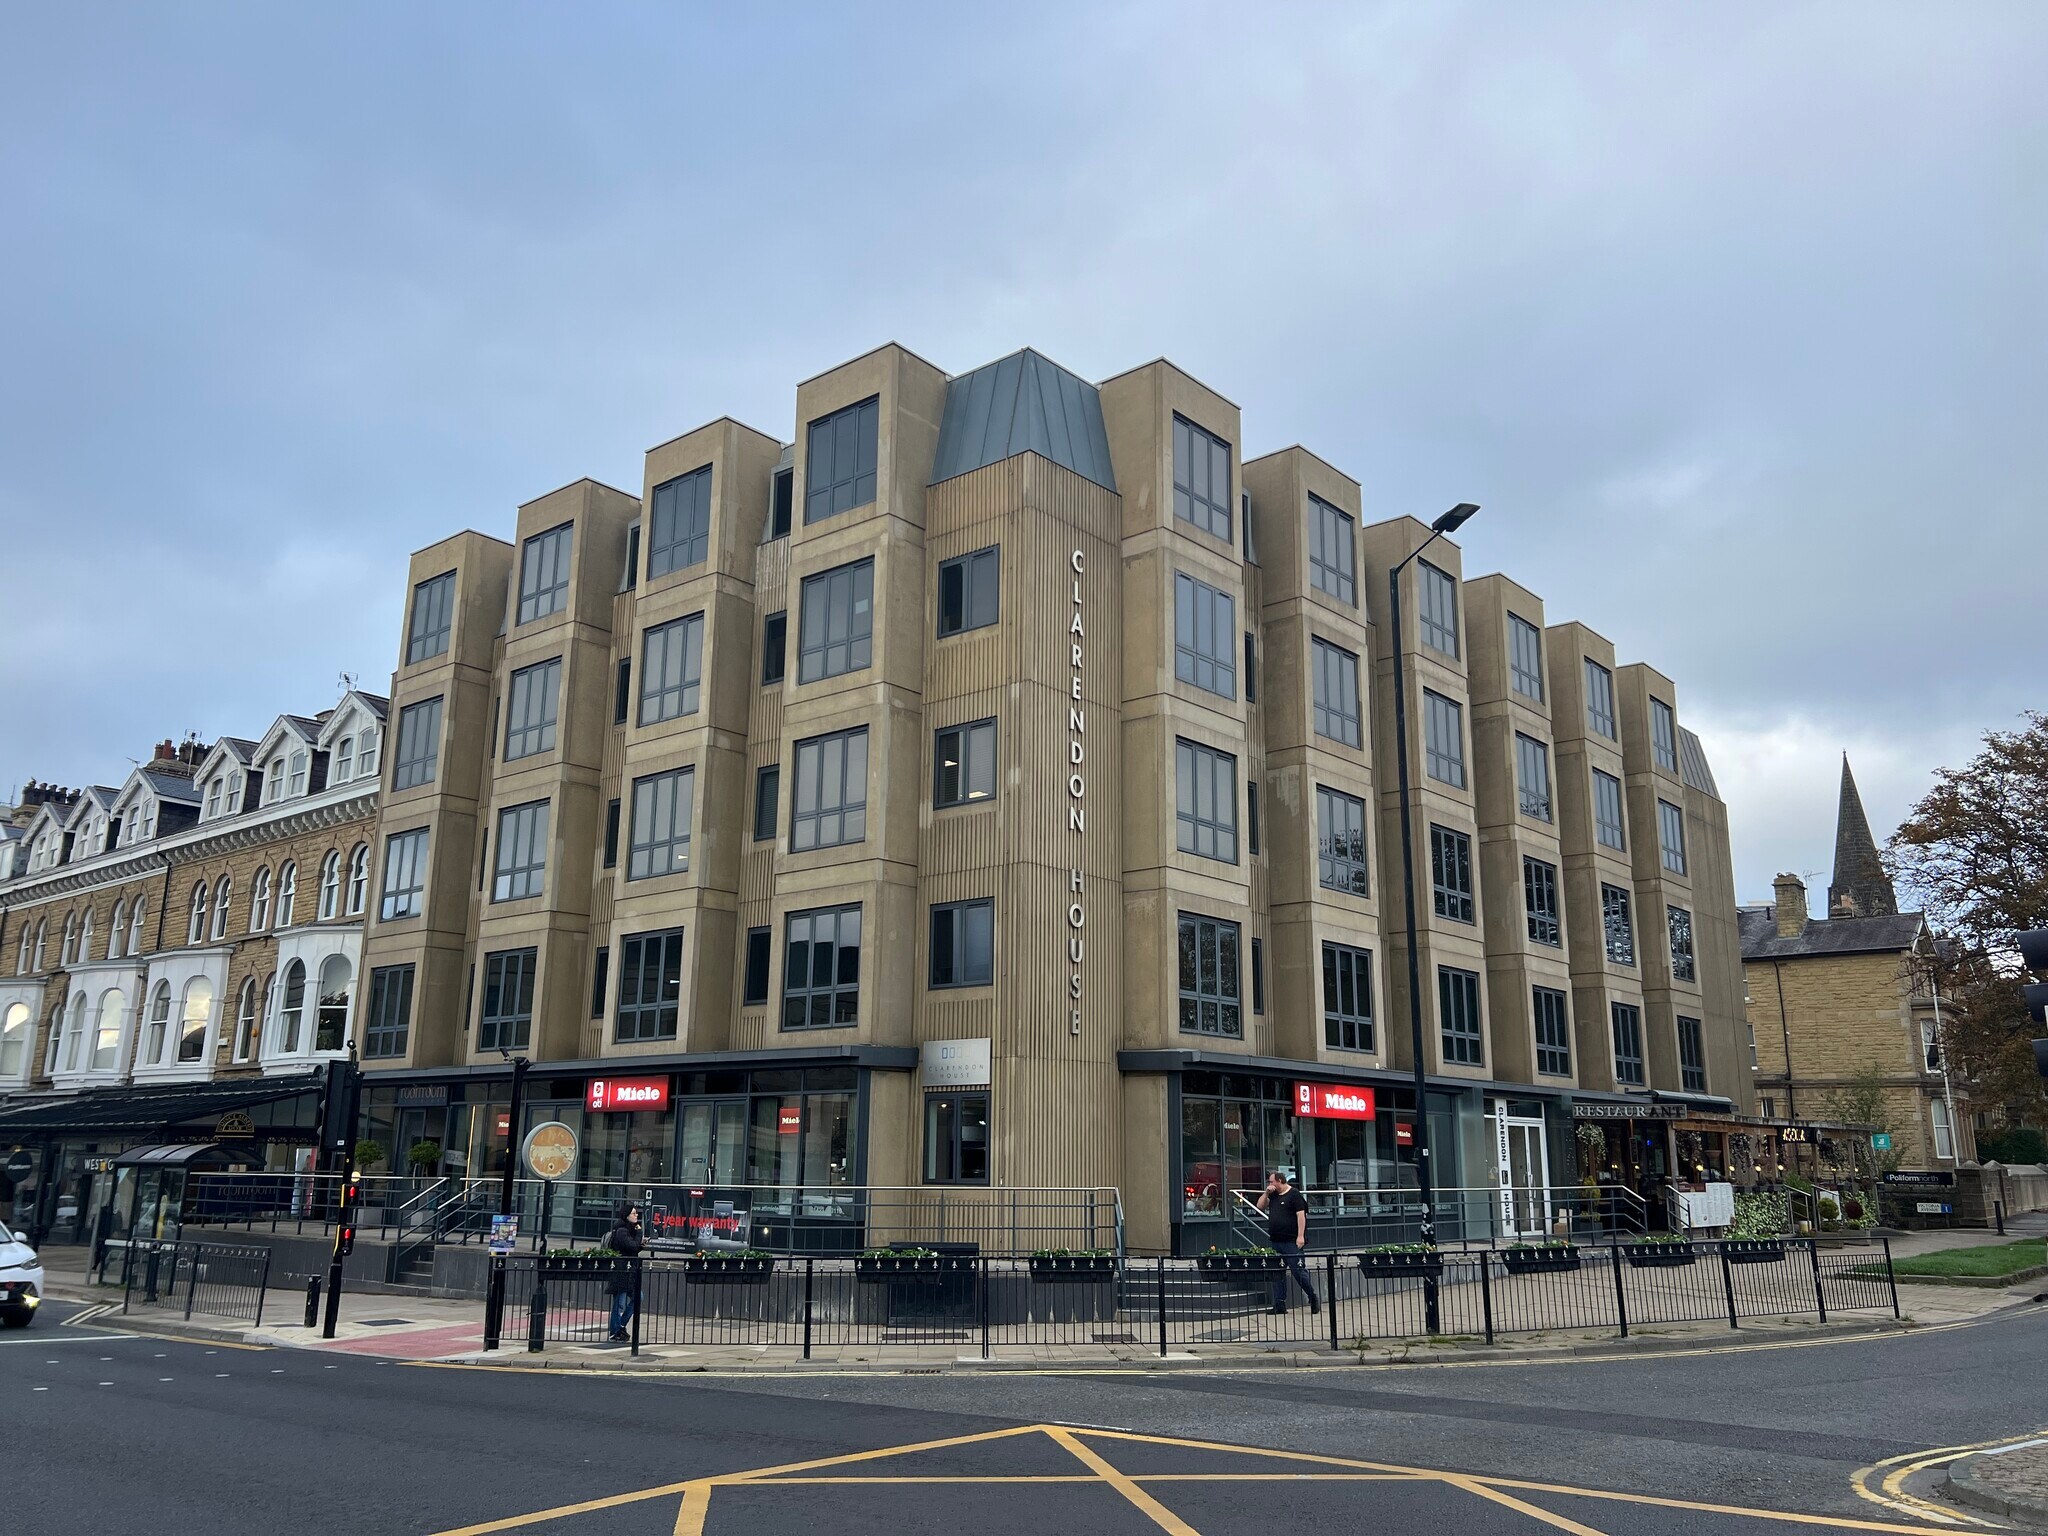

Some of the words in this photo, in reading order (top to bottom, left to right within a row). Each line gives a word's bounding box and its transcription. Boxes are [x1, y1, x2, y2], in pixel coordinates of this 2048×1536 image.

[1069, 550, 1084, 832] CLARENDON
[1068, 869, 1085, 1035] HOUSE
[928, 1064, 984, 1072] CLARENDON
[616, 1086, 661, 1102] Miele
[1325, 1093, 1367, 1112] Miele
[1574, 1105, 1684, 1118] RESTAURANT
[781, 1117, 800, 1125] Miel
[1396, 1130, 1411, 1138] Miele
[1498, 1106, 1508, 1162] CLARENDON
[1504, 1193, 1512, 1227] HOUSE
[653, 1212, 662, 1226] 5
[662, 1214, 687, 1230] year
[688, 1216, 740, 1232] warranty
